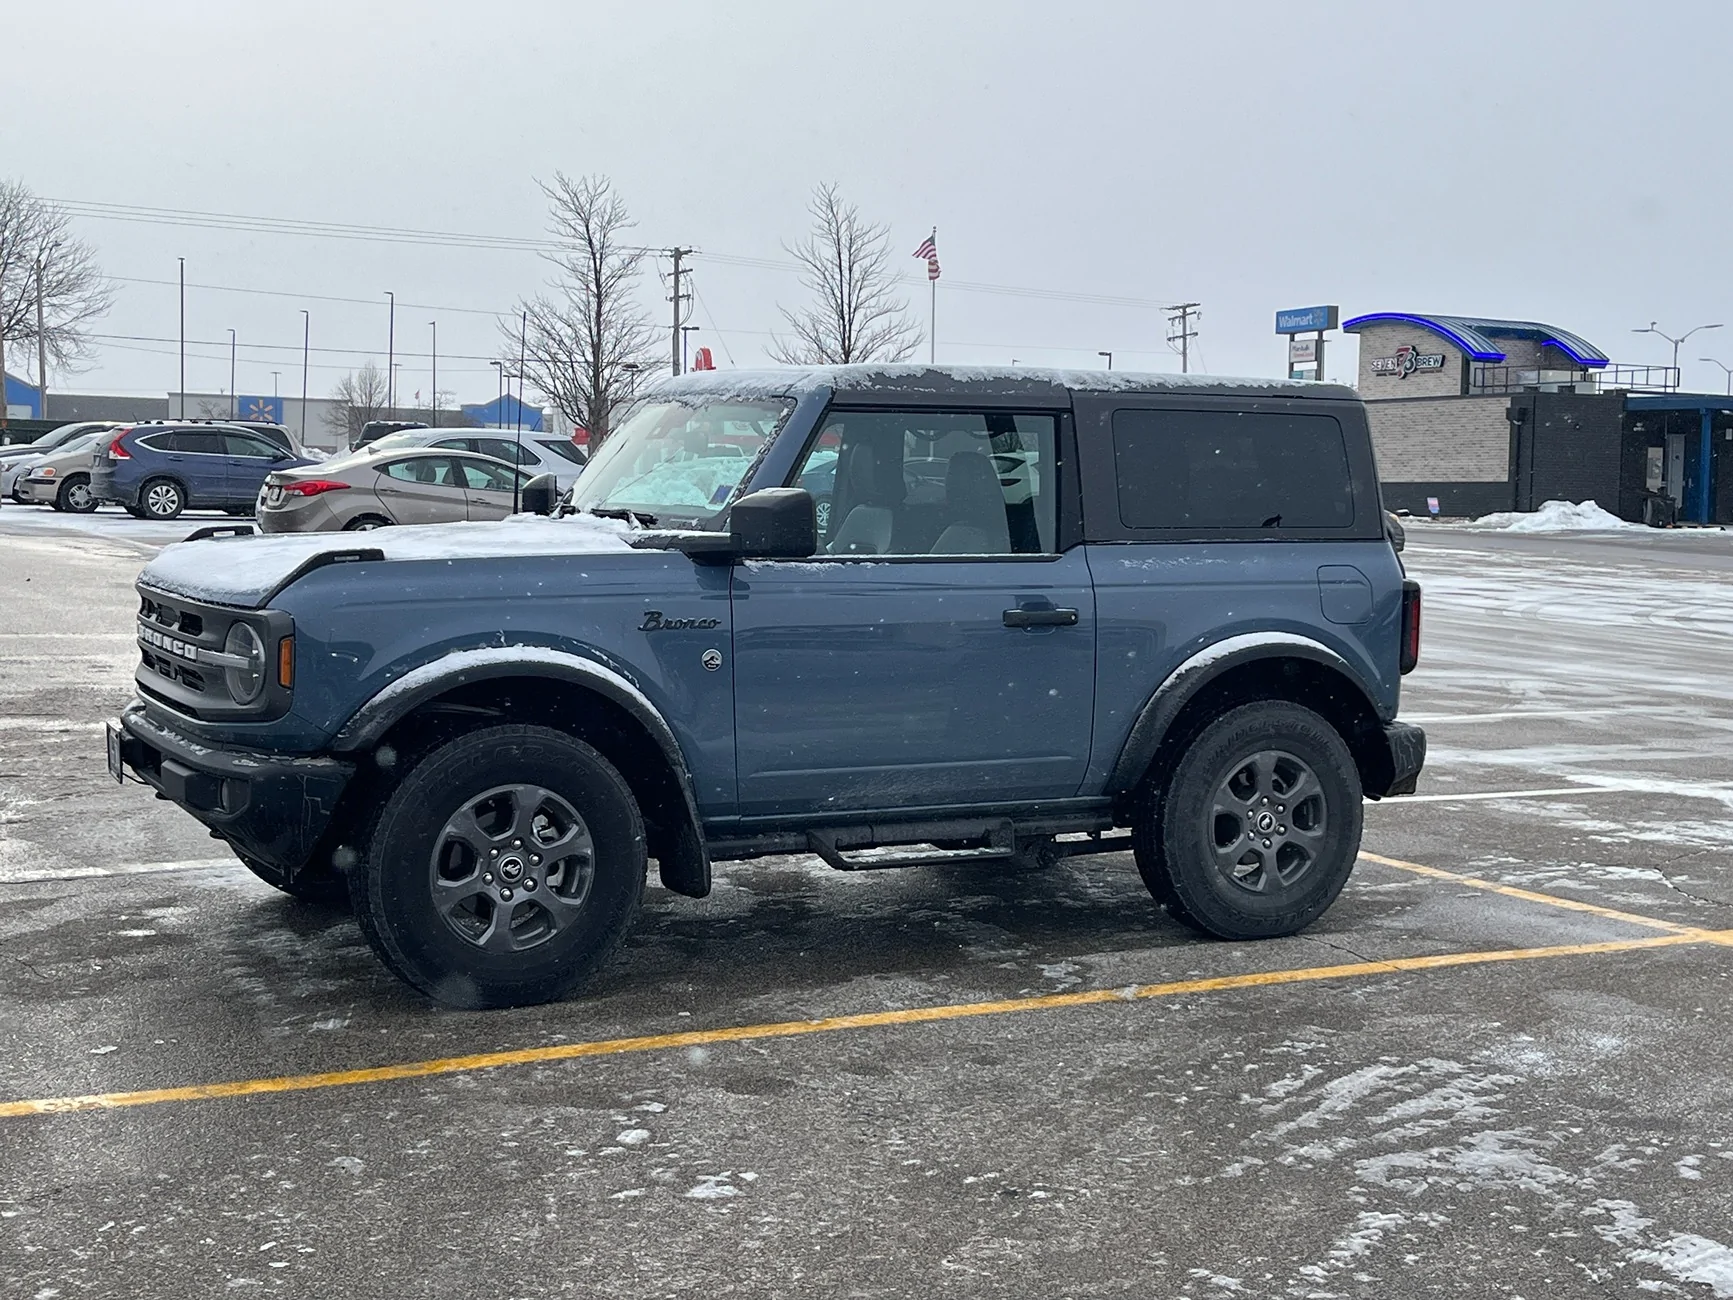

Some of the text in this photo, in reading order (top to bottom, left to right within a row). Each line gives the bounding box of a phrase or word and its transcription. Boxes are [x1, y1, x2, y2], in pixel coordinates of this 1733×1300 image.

[1278, 313, 1313, 328] Walmart
[1371, 357, 1397, 371] SEVEN
[1416, 355, 1443, 369] BREW
[637, 610, 722, 632] Bronco
